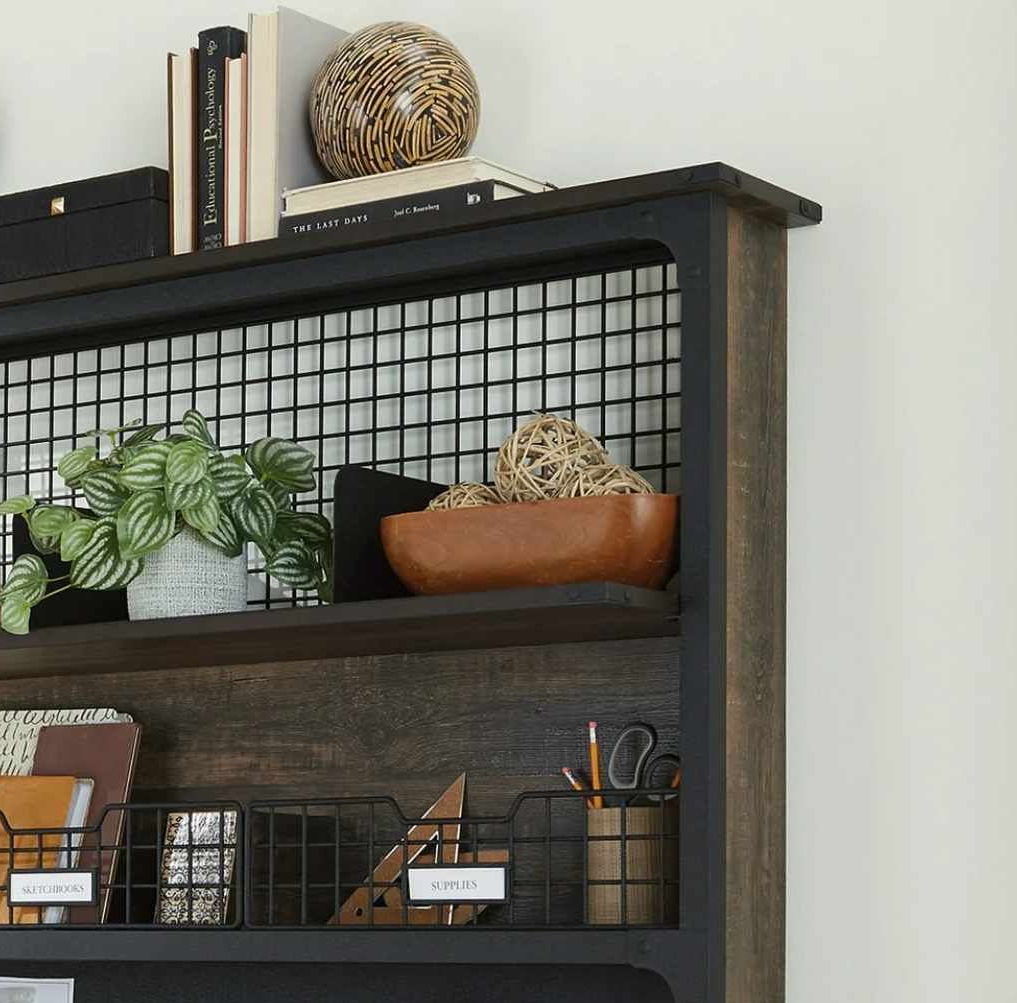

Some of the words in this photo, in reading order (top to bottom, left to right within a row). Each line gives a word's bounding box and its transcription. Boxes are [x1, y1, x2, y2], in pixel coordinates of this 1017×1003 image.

[203, 67, 219, 143] Psychology
[204, 145, 217, 226] Educational
[393, 208, 404, 218] Joel
[292, 224, 312, 233] THE
[316, 219, 340, 230] LAST
[344, 214, 368, 225] DAYS
[22, 884, 84, 895] SKETCHBOOKS
[431, 880, 478, 891] SUPPLIES
